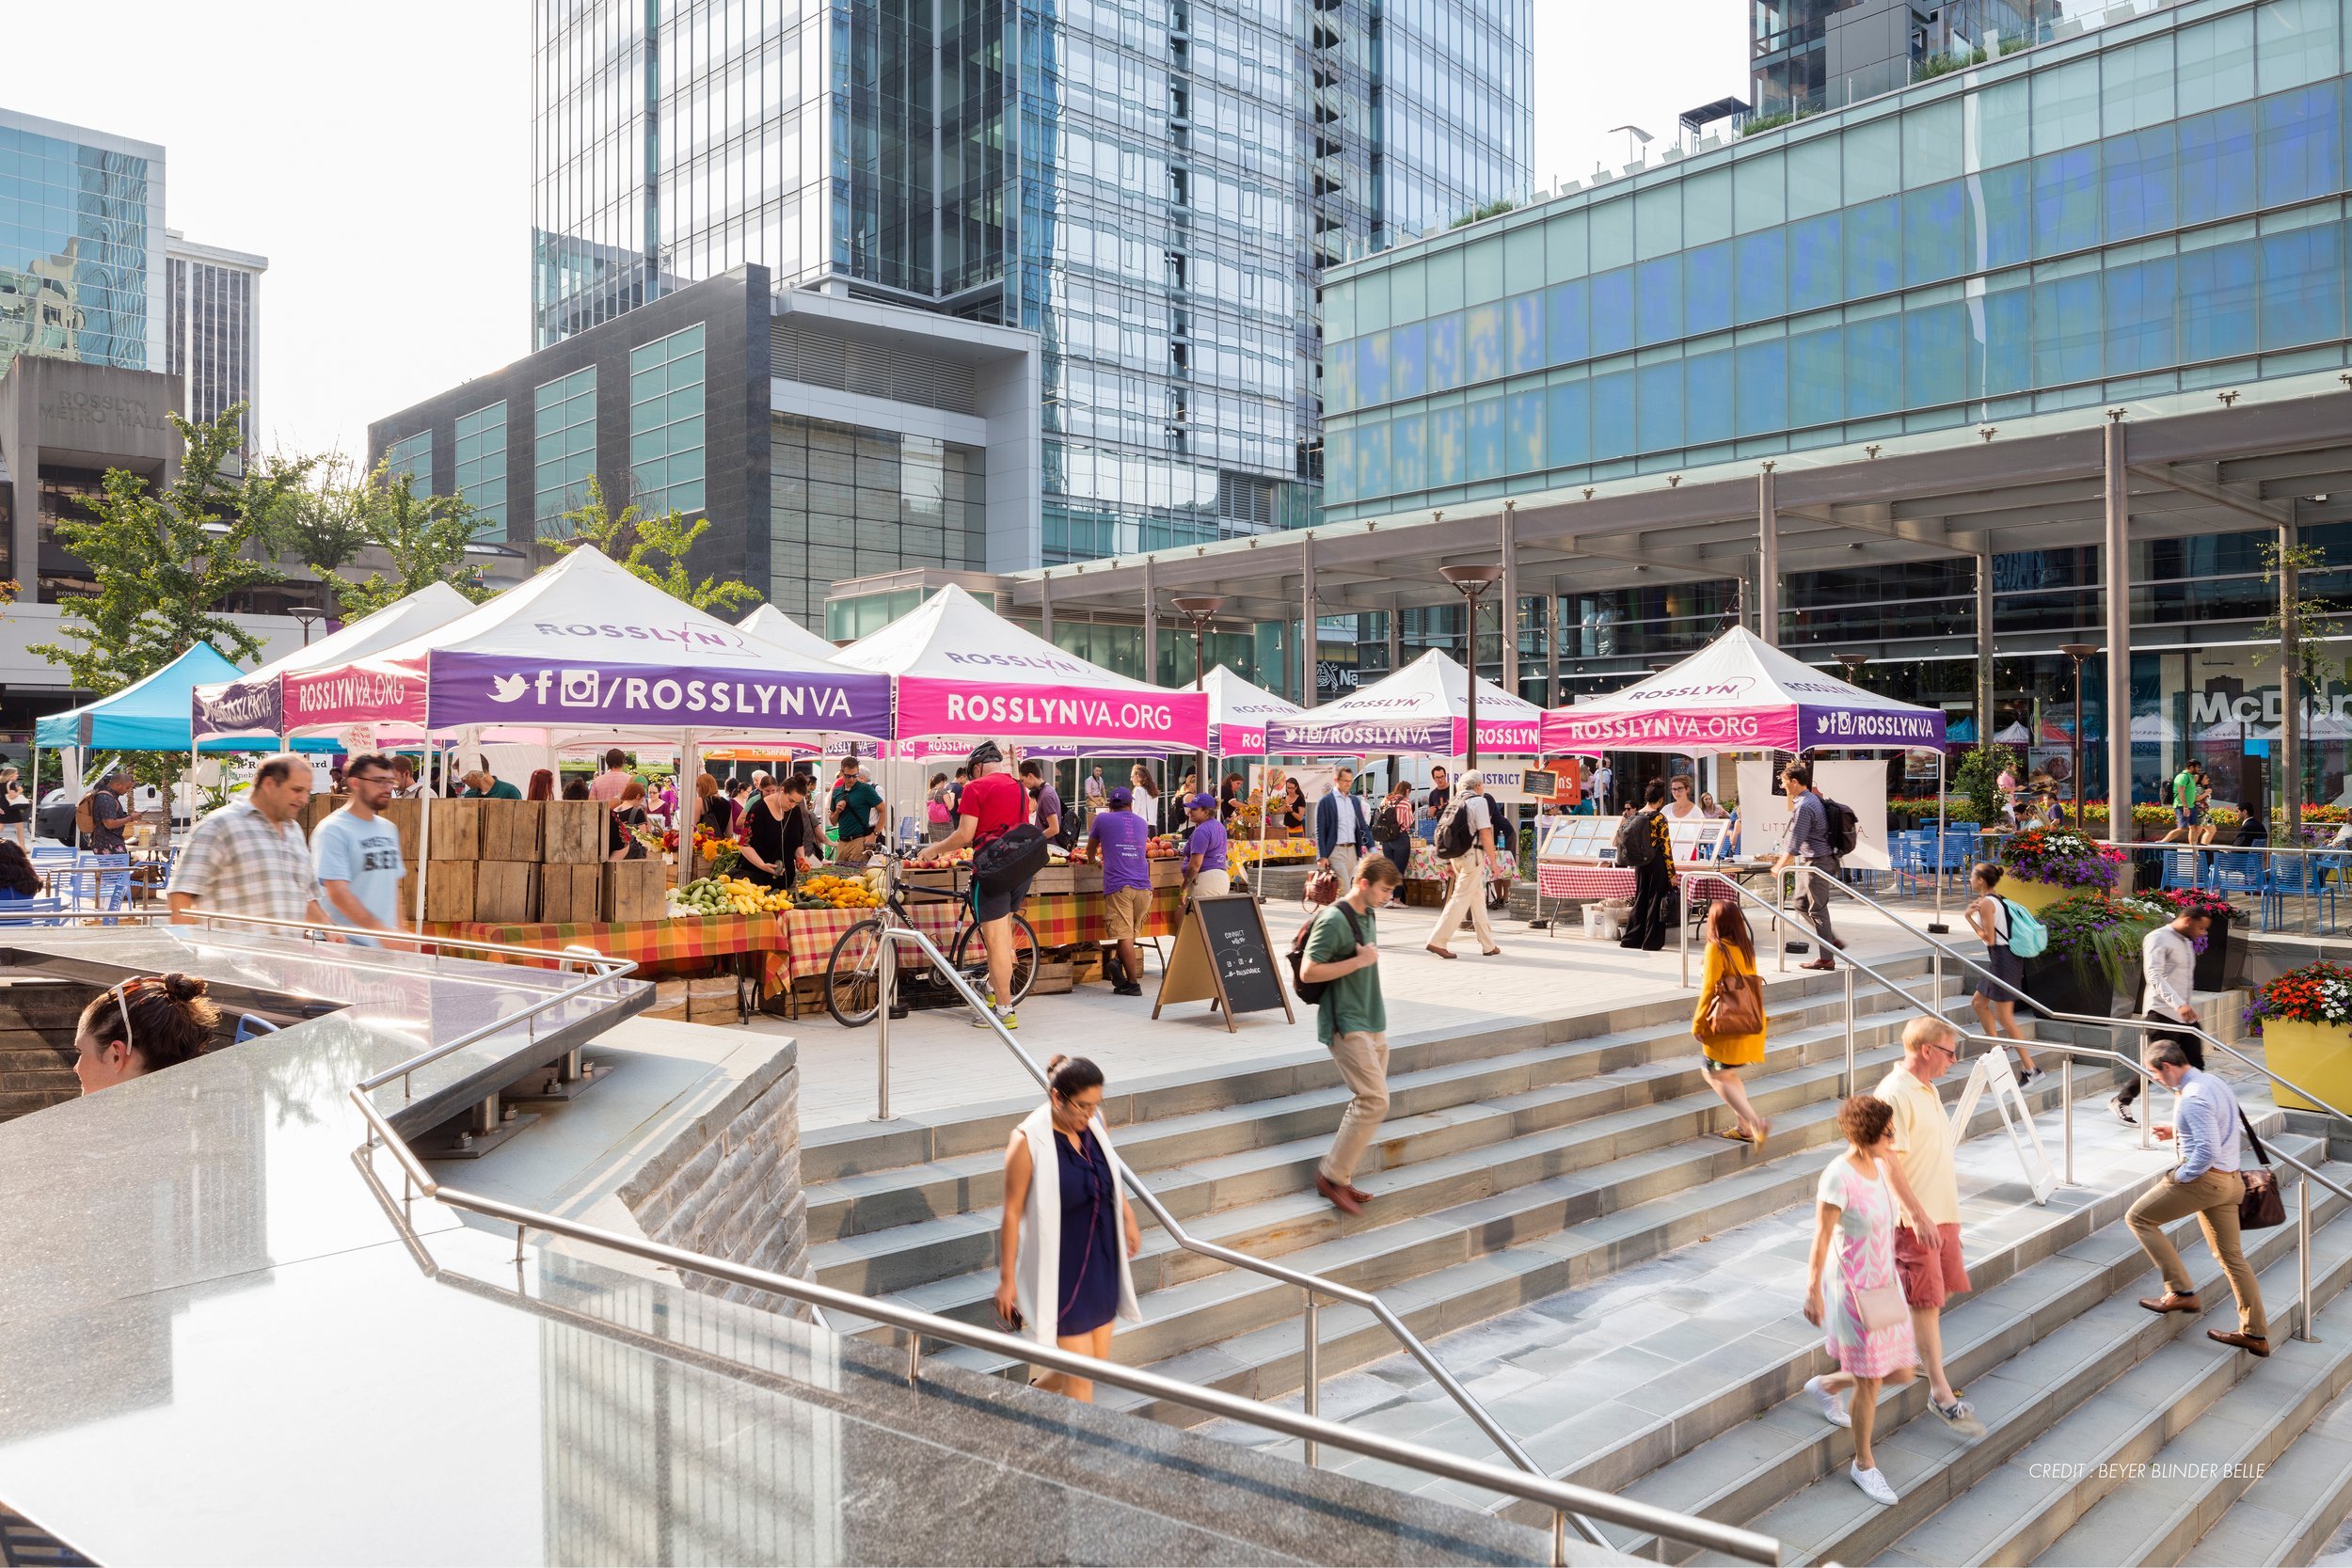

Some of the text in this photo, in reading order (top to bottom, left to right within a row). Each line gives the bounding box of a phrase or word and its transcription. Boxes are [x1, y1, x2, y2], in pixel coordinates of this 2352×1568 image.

[59, 390, 148, 414] ROSSLYN
[39, 403, 166, 431] METRO MALL
[534, 623, 727, 647] ROSSLYN
[944, 651, 1080, 673] ROSSLYN
[299, 674, 405, 712] ROSSLYNVA.ORG
[601, 677, 852, 718] /ROSSLYNVA
[1629, 684, 1739, 701] ROSSLYN
[1782, 682, 1856, 696] ROSSLYN
[947, 693, 1172, 730] ROSSLYNVA.ORG
[1232, 705, 1296, 715] ROSSLYN
[1338, 698, 1421, 709] ROSSLYN
[1321, 726, 1432, 744] /ROSSLYNVA
[1570, 716, 1758, 739] ROSSLYNVA.ORG
[1851, 715, 1934, 737] /ROSSLYNVA
[824, 740, 868, 754] OSSLYVA
[1478, 773, 1520, 785] ISTRICT
[1762, 823, 1791, 832] LITT
